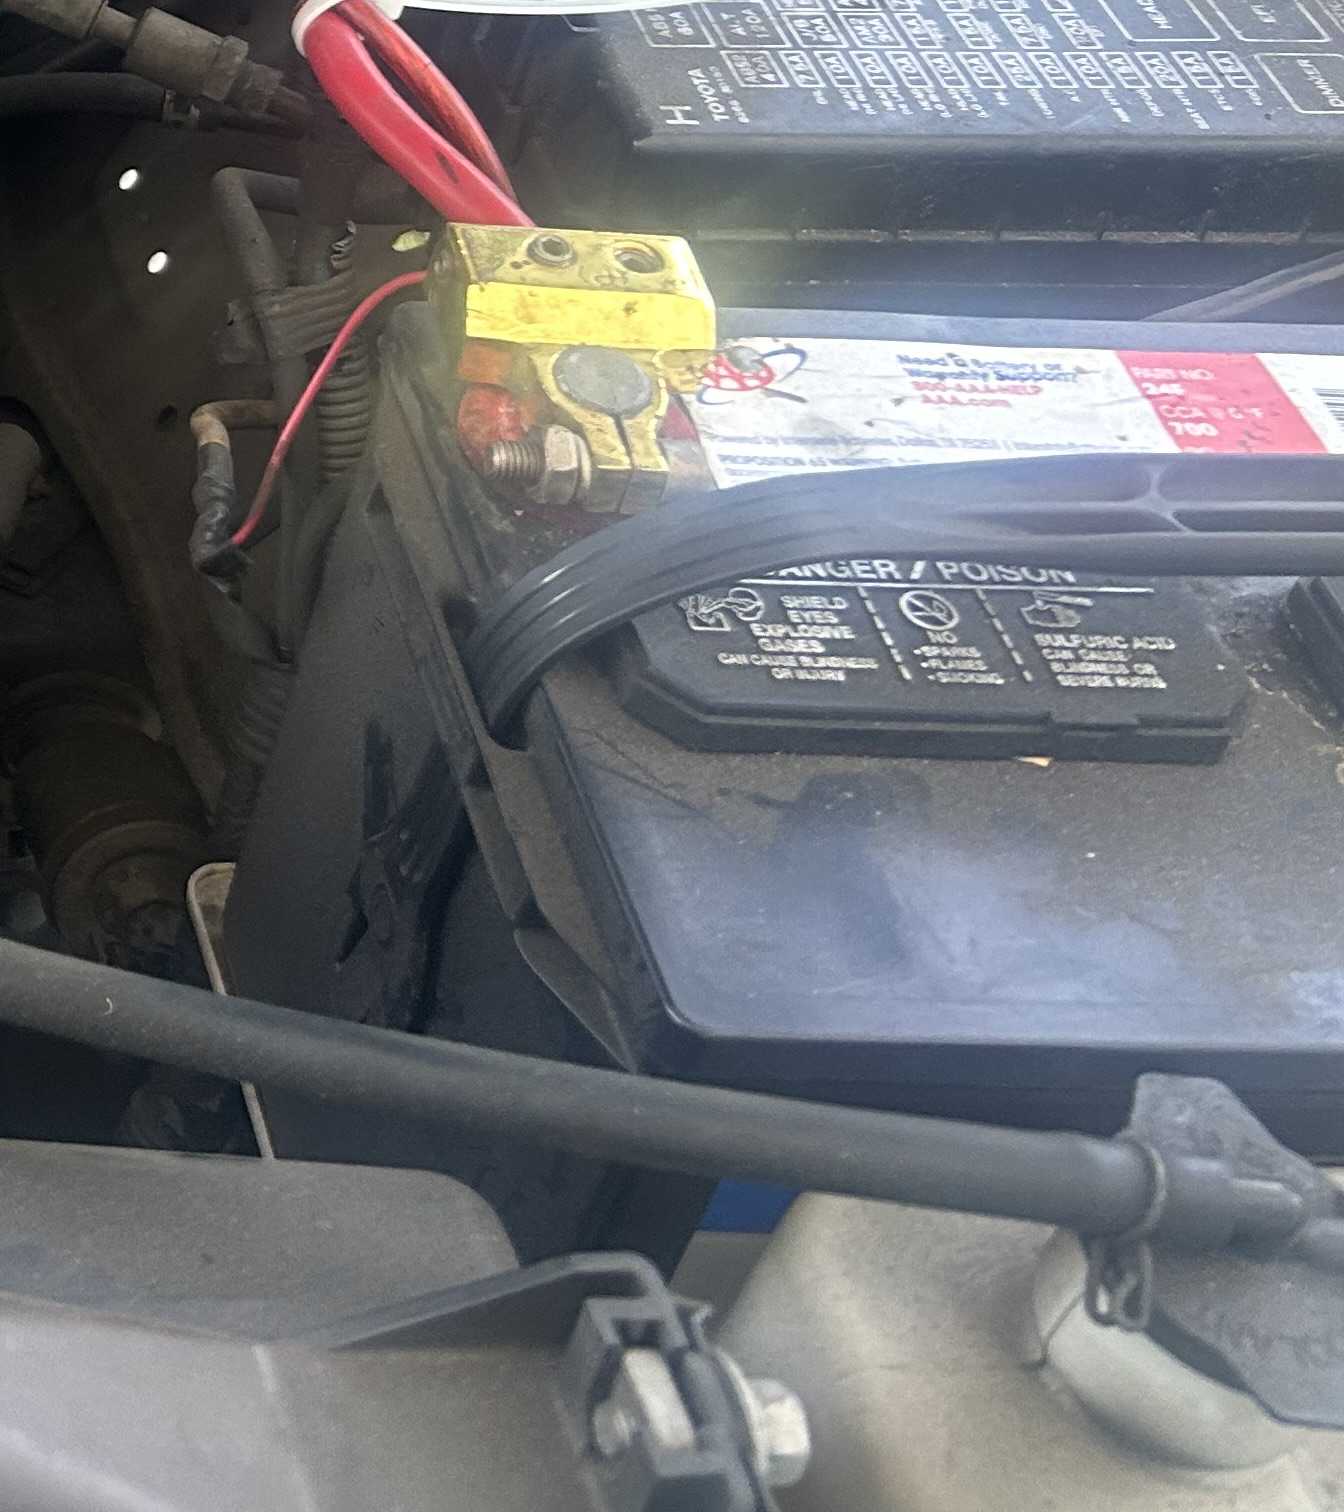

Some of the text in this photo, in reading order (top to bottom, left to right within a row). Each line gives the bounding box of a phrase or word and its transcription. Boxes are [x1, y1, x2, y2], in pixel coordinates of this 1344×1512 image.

[723, 12, 746, 35] ALT
[741, 8, 769, 39] 120A
[824, 56, 849, 79] 10A
[860, 56, 885, 79] 10A
[895, 56, 920, 79] 10A
[932, 57, 957, 79] 10A
[968, 57, 993, 80] 10A
[1039, 57, 1065, 80] 10A
[1075, 57, 1101, 80] 10A
[684, 67, 731, 121] TOYOTA
[1159, 404, 1205, 419] CCA
[1168, 422, 1220, 438] 700
[764, 559, 902, 580] ANGER
[935, 560, 1078, 583] POISON
[780, 595, 849, 610] SHIELD
[787, 609, 841, 624] EYES
[749, 623, 858, 639] EXPLOSIVE
[926, 630, 959, 645] NO
[758, 639, 826, 653] GASES
[1034, 633, 1177, 651] SULFURIC ACID
[717, 652, 749, 665] CAN
[750, 654, 798, 667] CAUSE
[1041, 648, 1076, 660] CAN
[771, 668, 794, 680] OR
